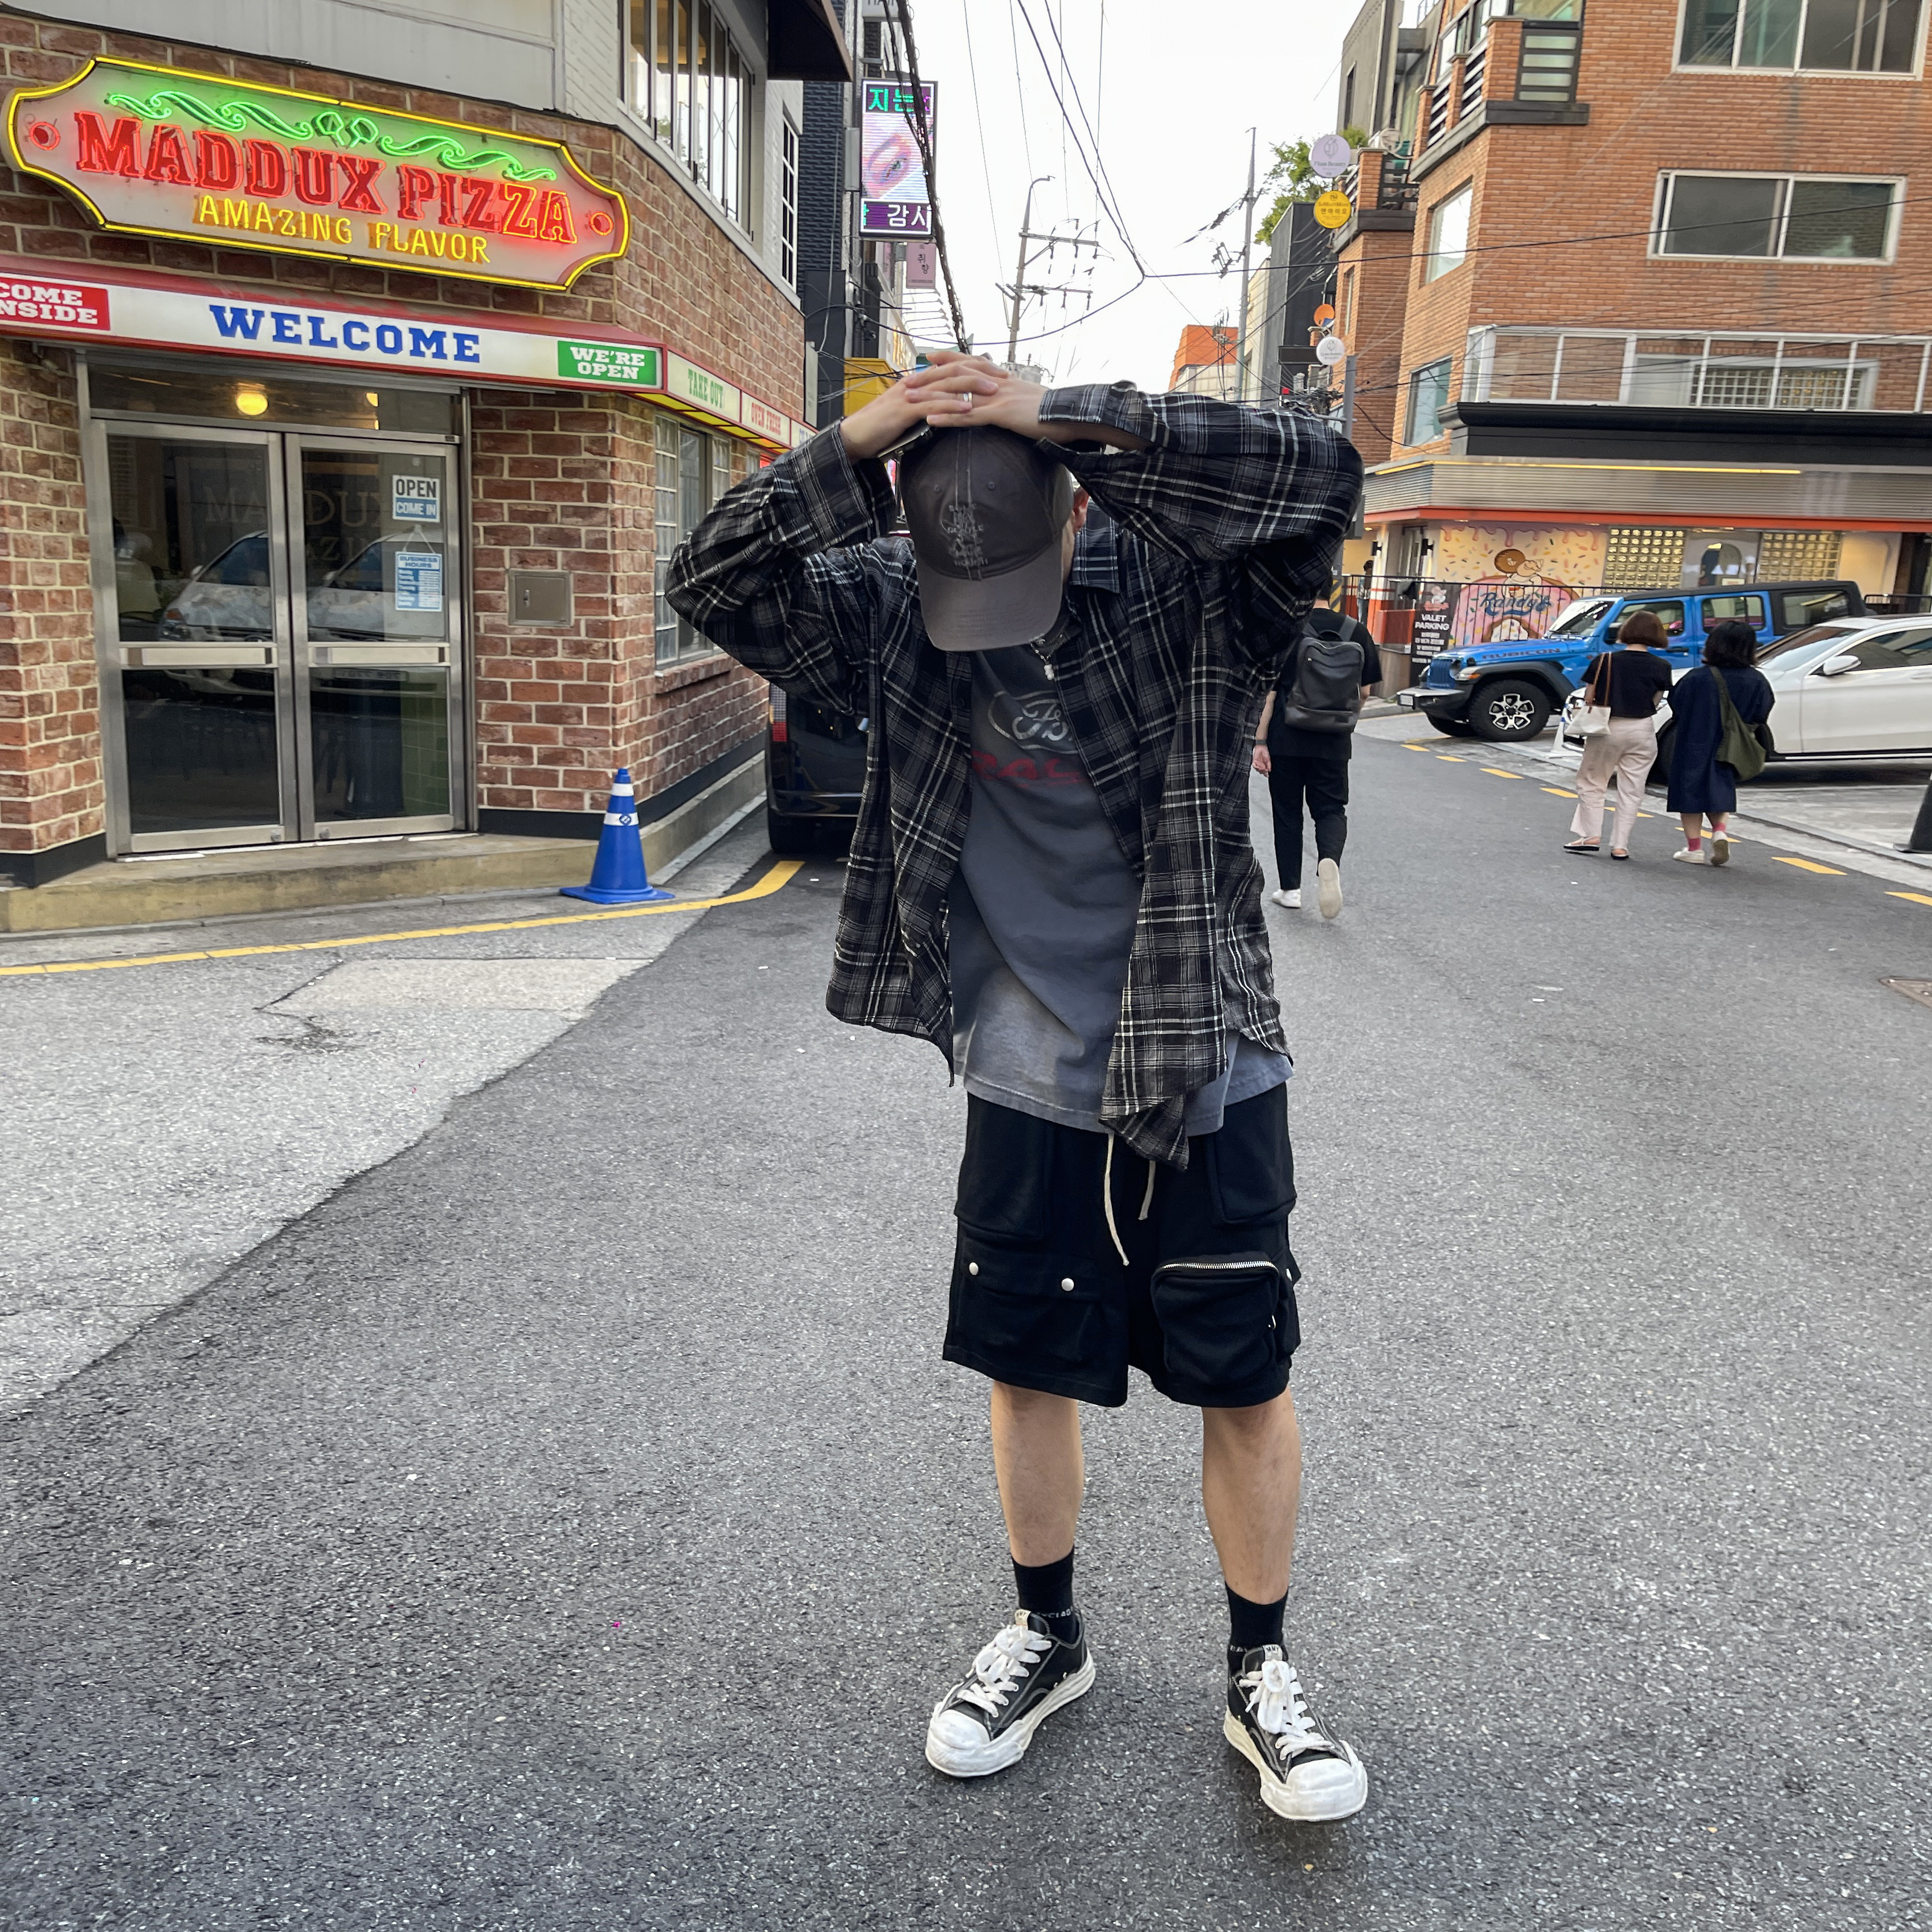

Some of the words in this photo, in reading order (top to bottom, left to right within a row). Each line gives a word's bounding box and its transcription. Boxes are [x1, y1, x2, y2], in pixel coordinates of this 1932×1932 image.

[75, 110, 388, 215] MADDUX
[397, 163, 578, 244] PIZZA
[194, 195, 353, 245] AMAZING
[370, 221, 491, 265] FLAVOR
[209, 304, 480, 364] WELCOME
[570, 346, 645, 367] WE'RE
[577, 361, 640, 380] OPEN
[688, 368, 708, 402] TAKE
[710, 380, 723, 409] OUT
[751, 402, 764, 428] OVEN
[396, 478, 437, 498] OPEN
[396, 501, 424, 515] COME
[426, 504, 436, 516] IN
[1414, 621, 1450, 631] PARKING
[1421, 613, 1447, 622] VALET
[1482, 648, 1561, 660] RUBICON
